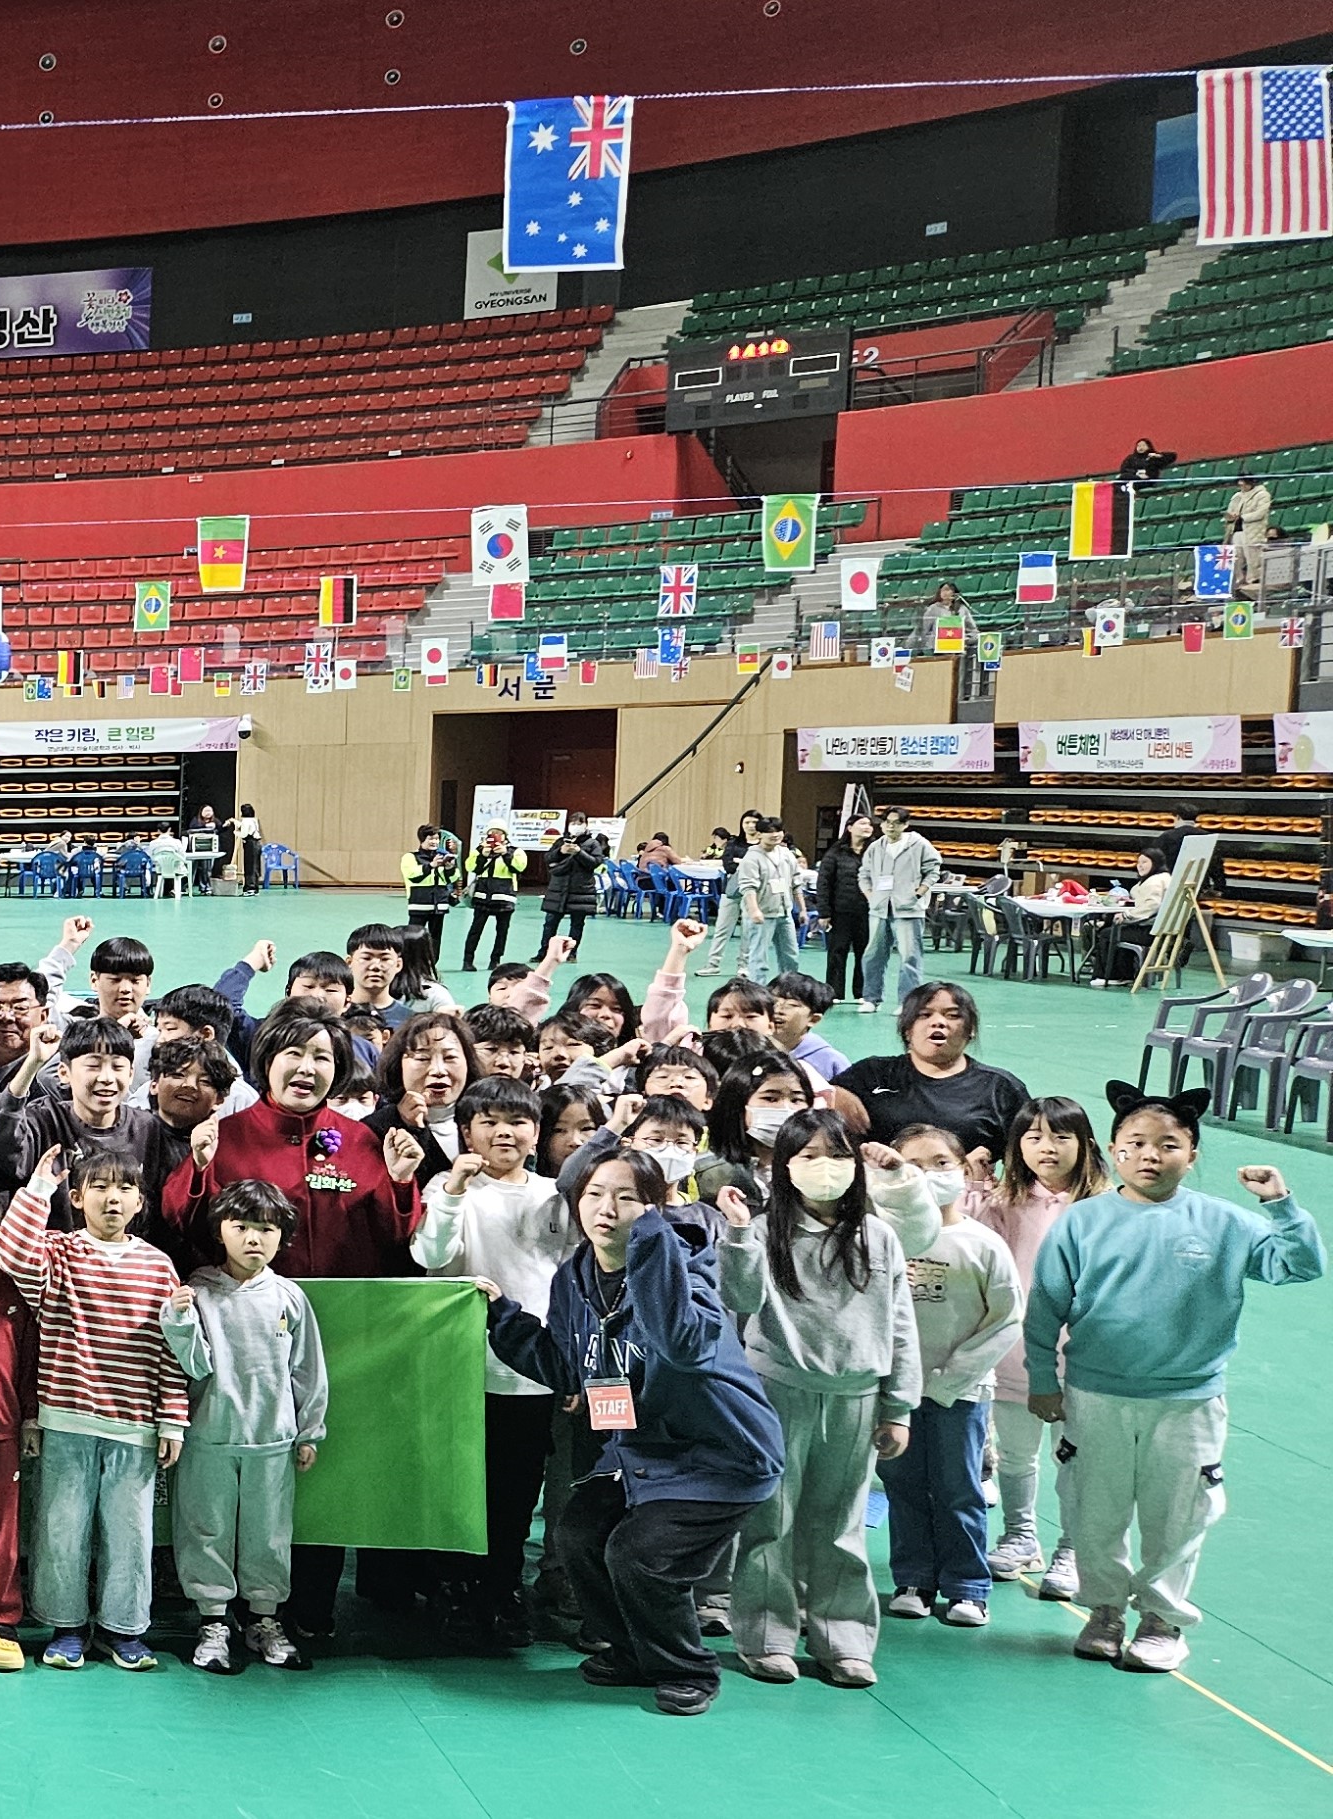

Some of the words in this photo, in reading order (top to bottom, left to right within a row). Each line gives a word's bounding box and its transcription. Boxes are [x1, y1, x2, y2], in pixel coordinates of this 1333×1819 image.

[474, 293, 548, 310] GYEONGSAN
[35, 728, 63, 743] 작은
[67, 727, 100, 743] 키링,
[108, 728, 122, 742] 큰
[126, 726, 155, 742] 힐링
[594, 1399, 629, 1416] STAFF
